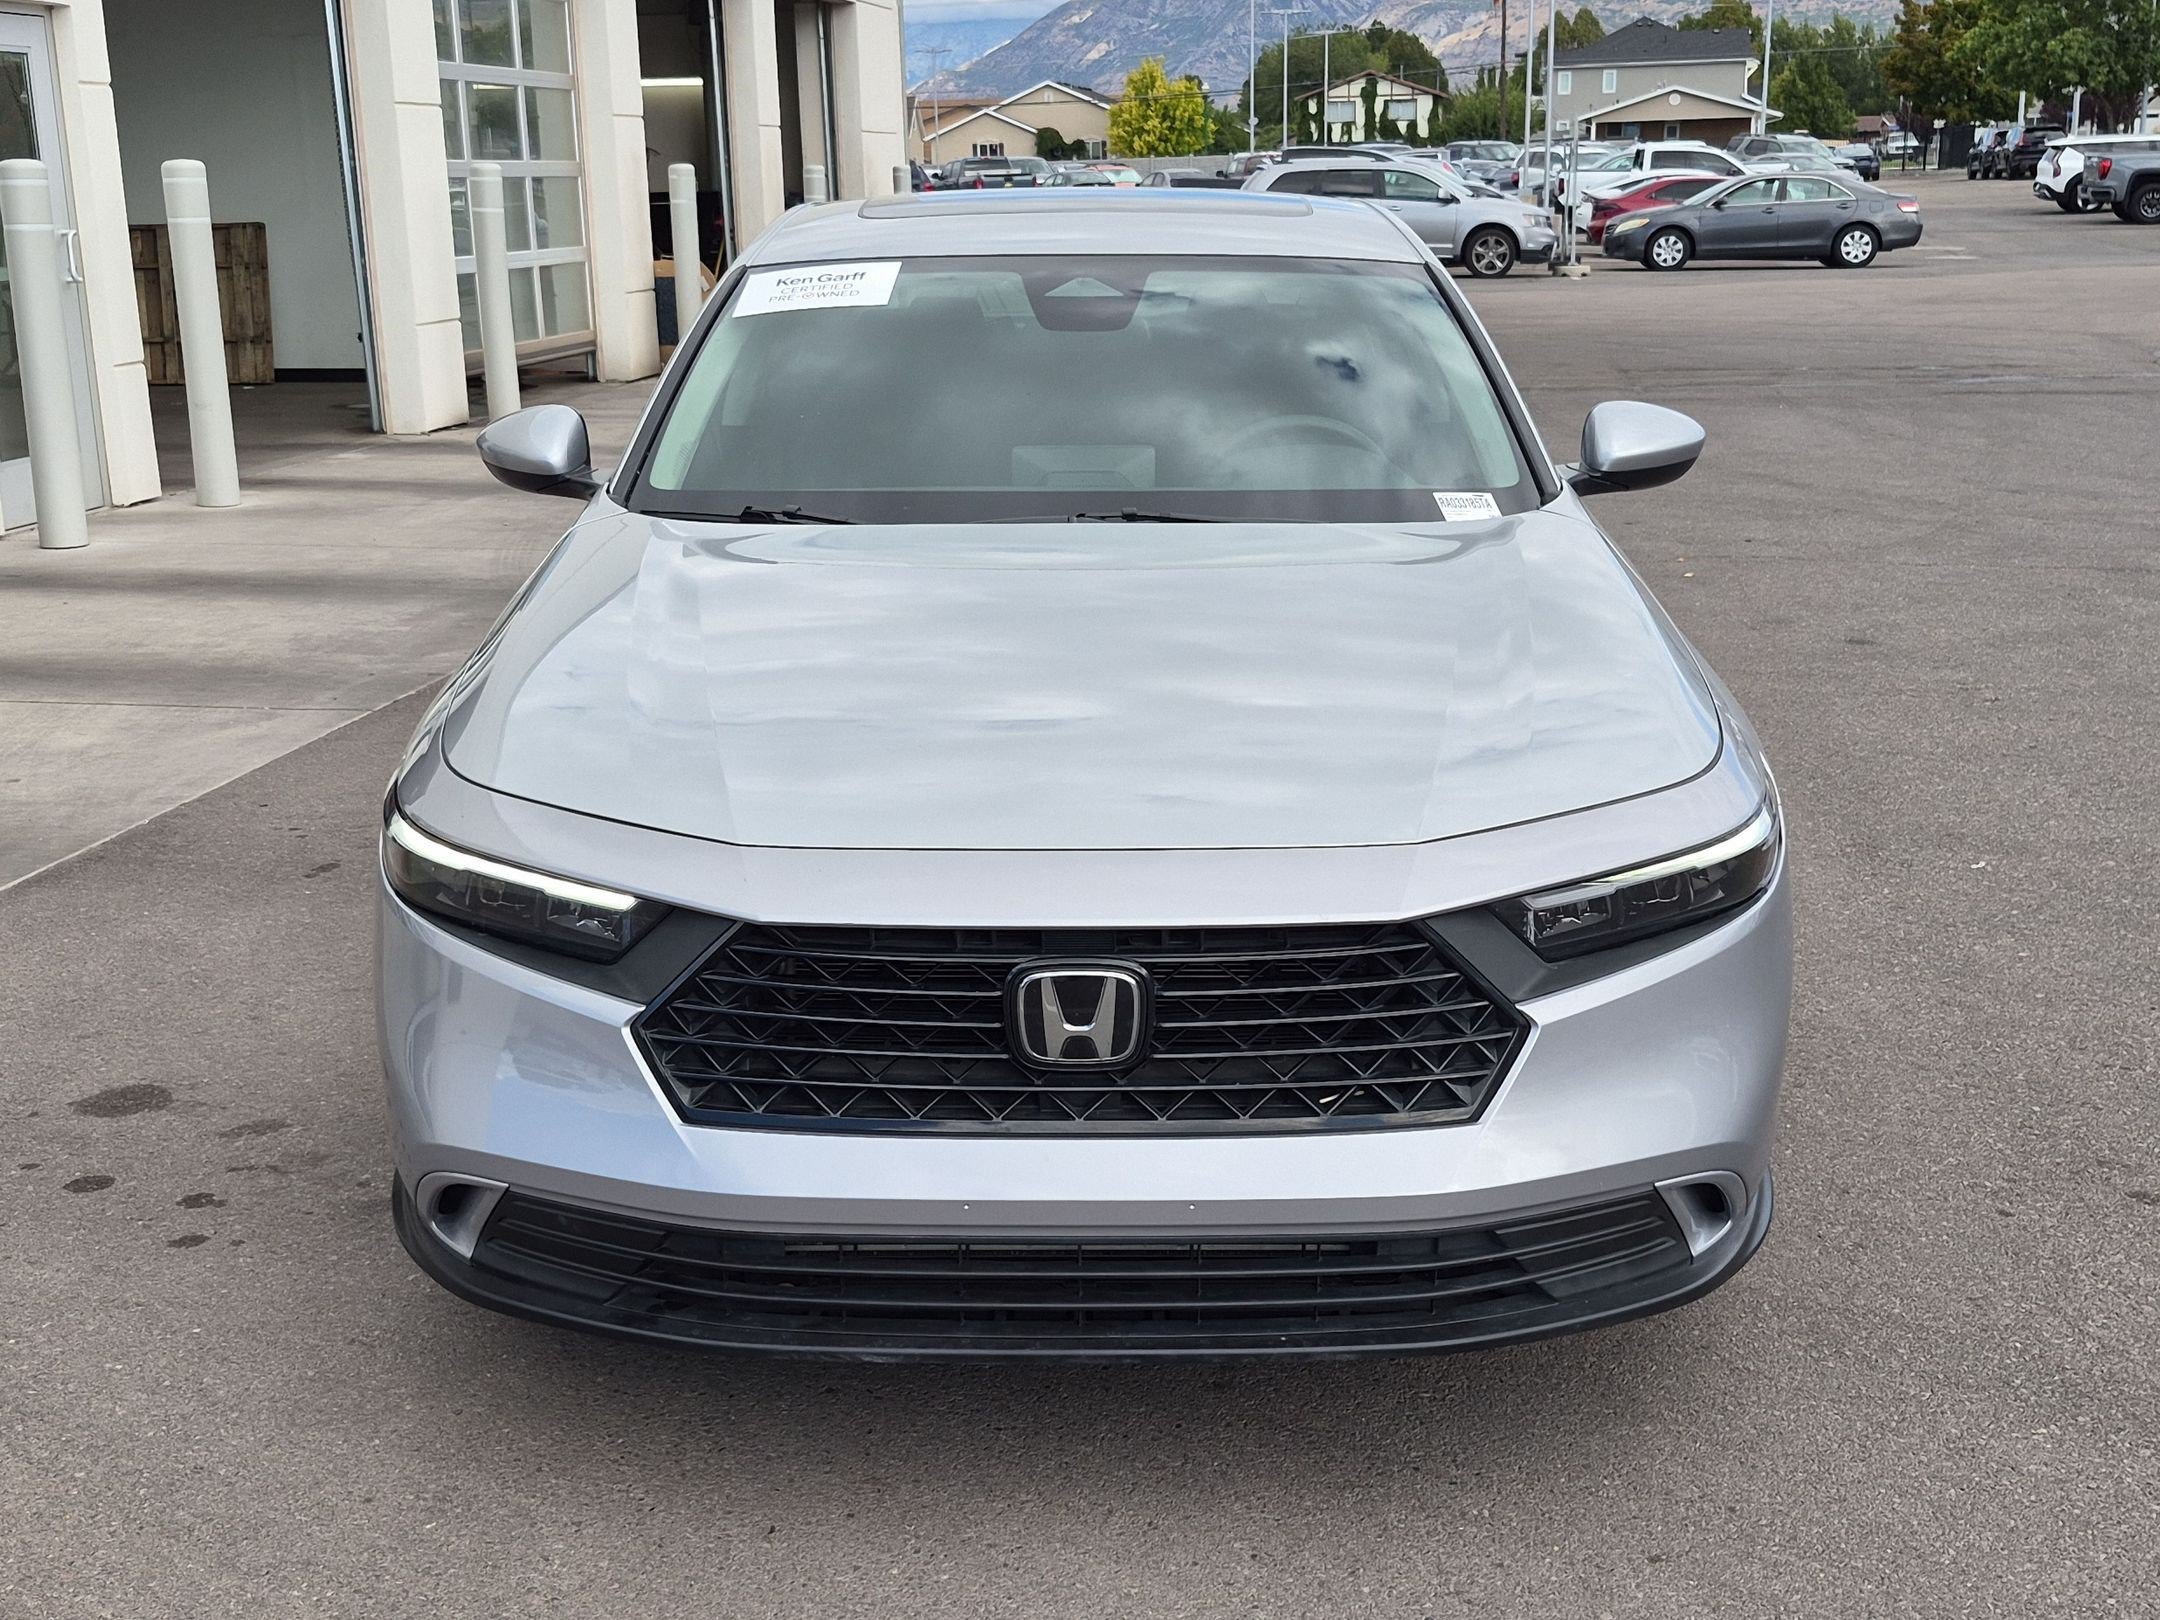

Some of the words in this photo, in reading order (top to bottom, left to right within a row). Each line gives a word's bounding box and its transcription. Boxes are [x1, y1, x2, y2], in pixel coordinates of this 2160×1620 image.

[775, 276, 813, 287] Ken
[817, 271, 866, 283] Garff
[780, 282, 854, 295] CERTIFIED
